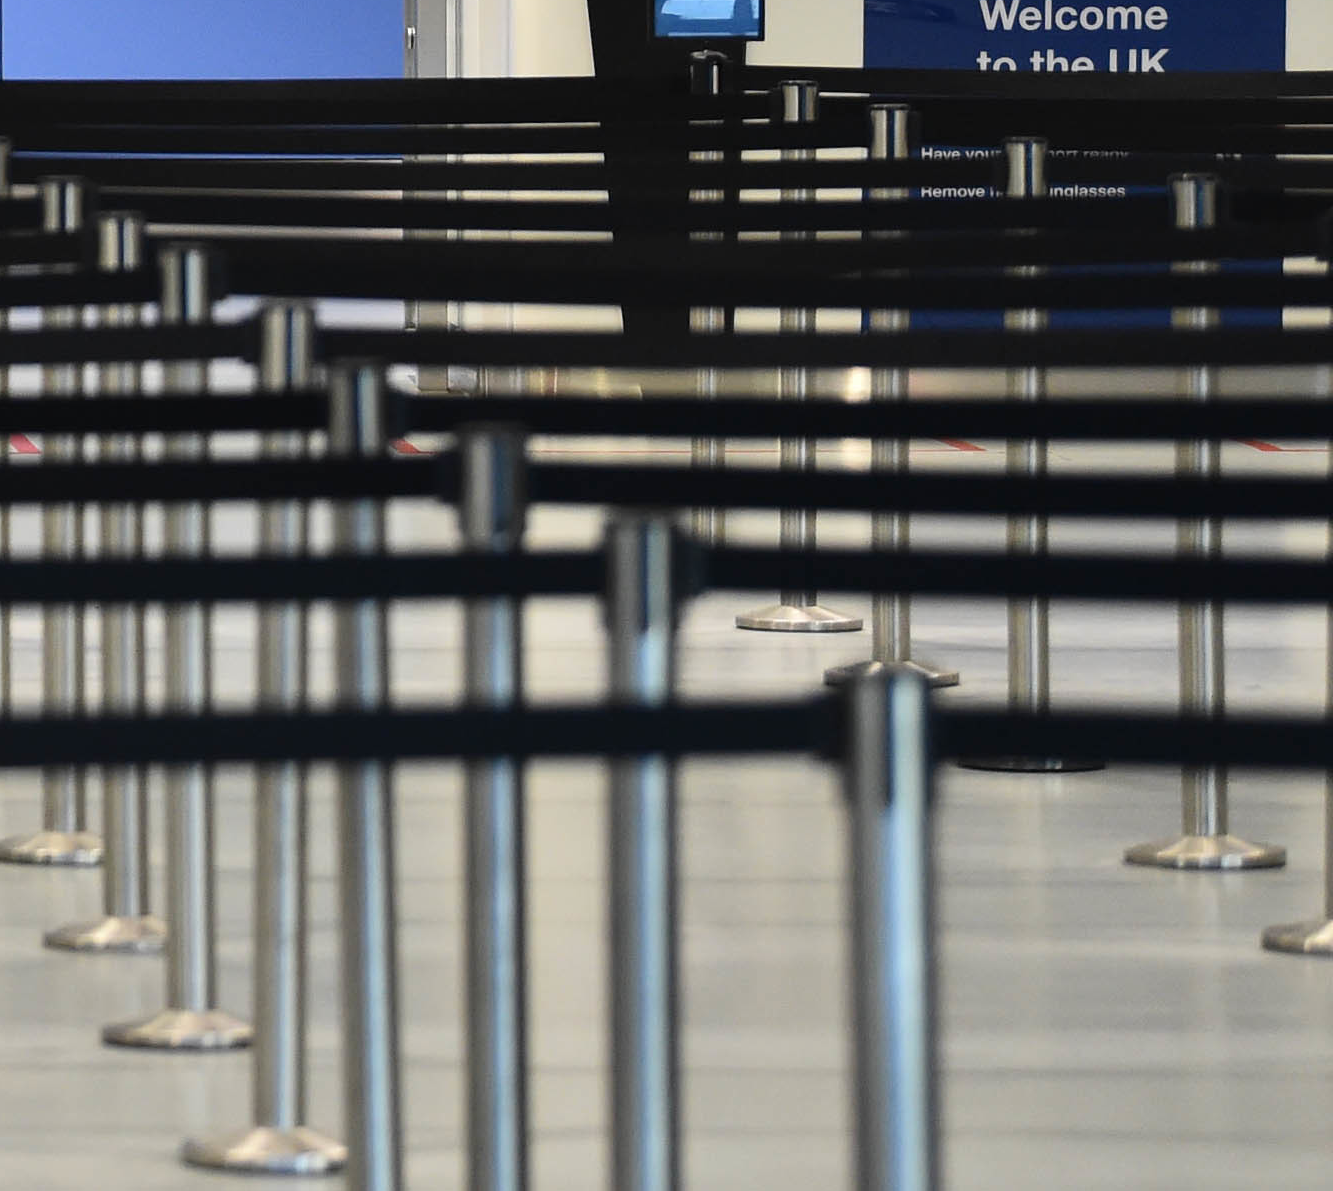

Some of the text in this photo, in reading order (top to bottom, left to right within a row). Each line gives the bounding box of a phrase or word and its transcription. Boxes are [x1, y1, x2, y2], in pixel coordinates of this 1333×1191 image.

[976, 48, 1169, 72] to the UK
[920, 146, 961, 160] Have
[920, 186, 986, 198] Remove
